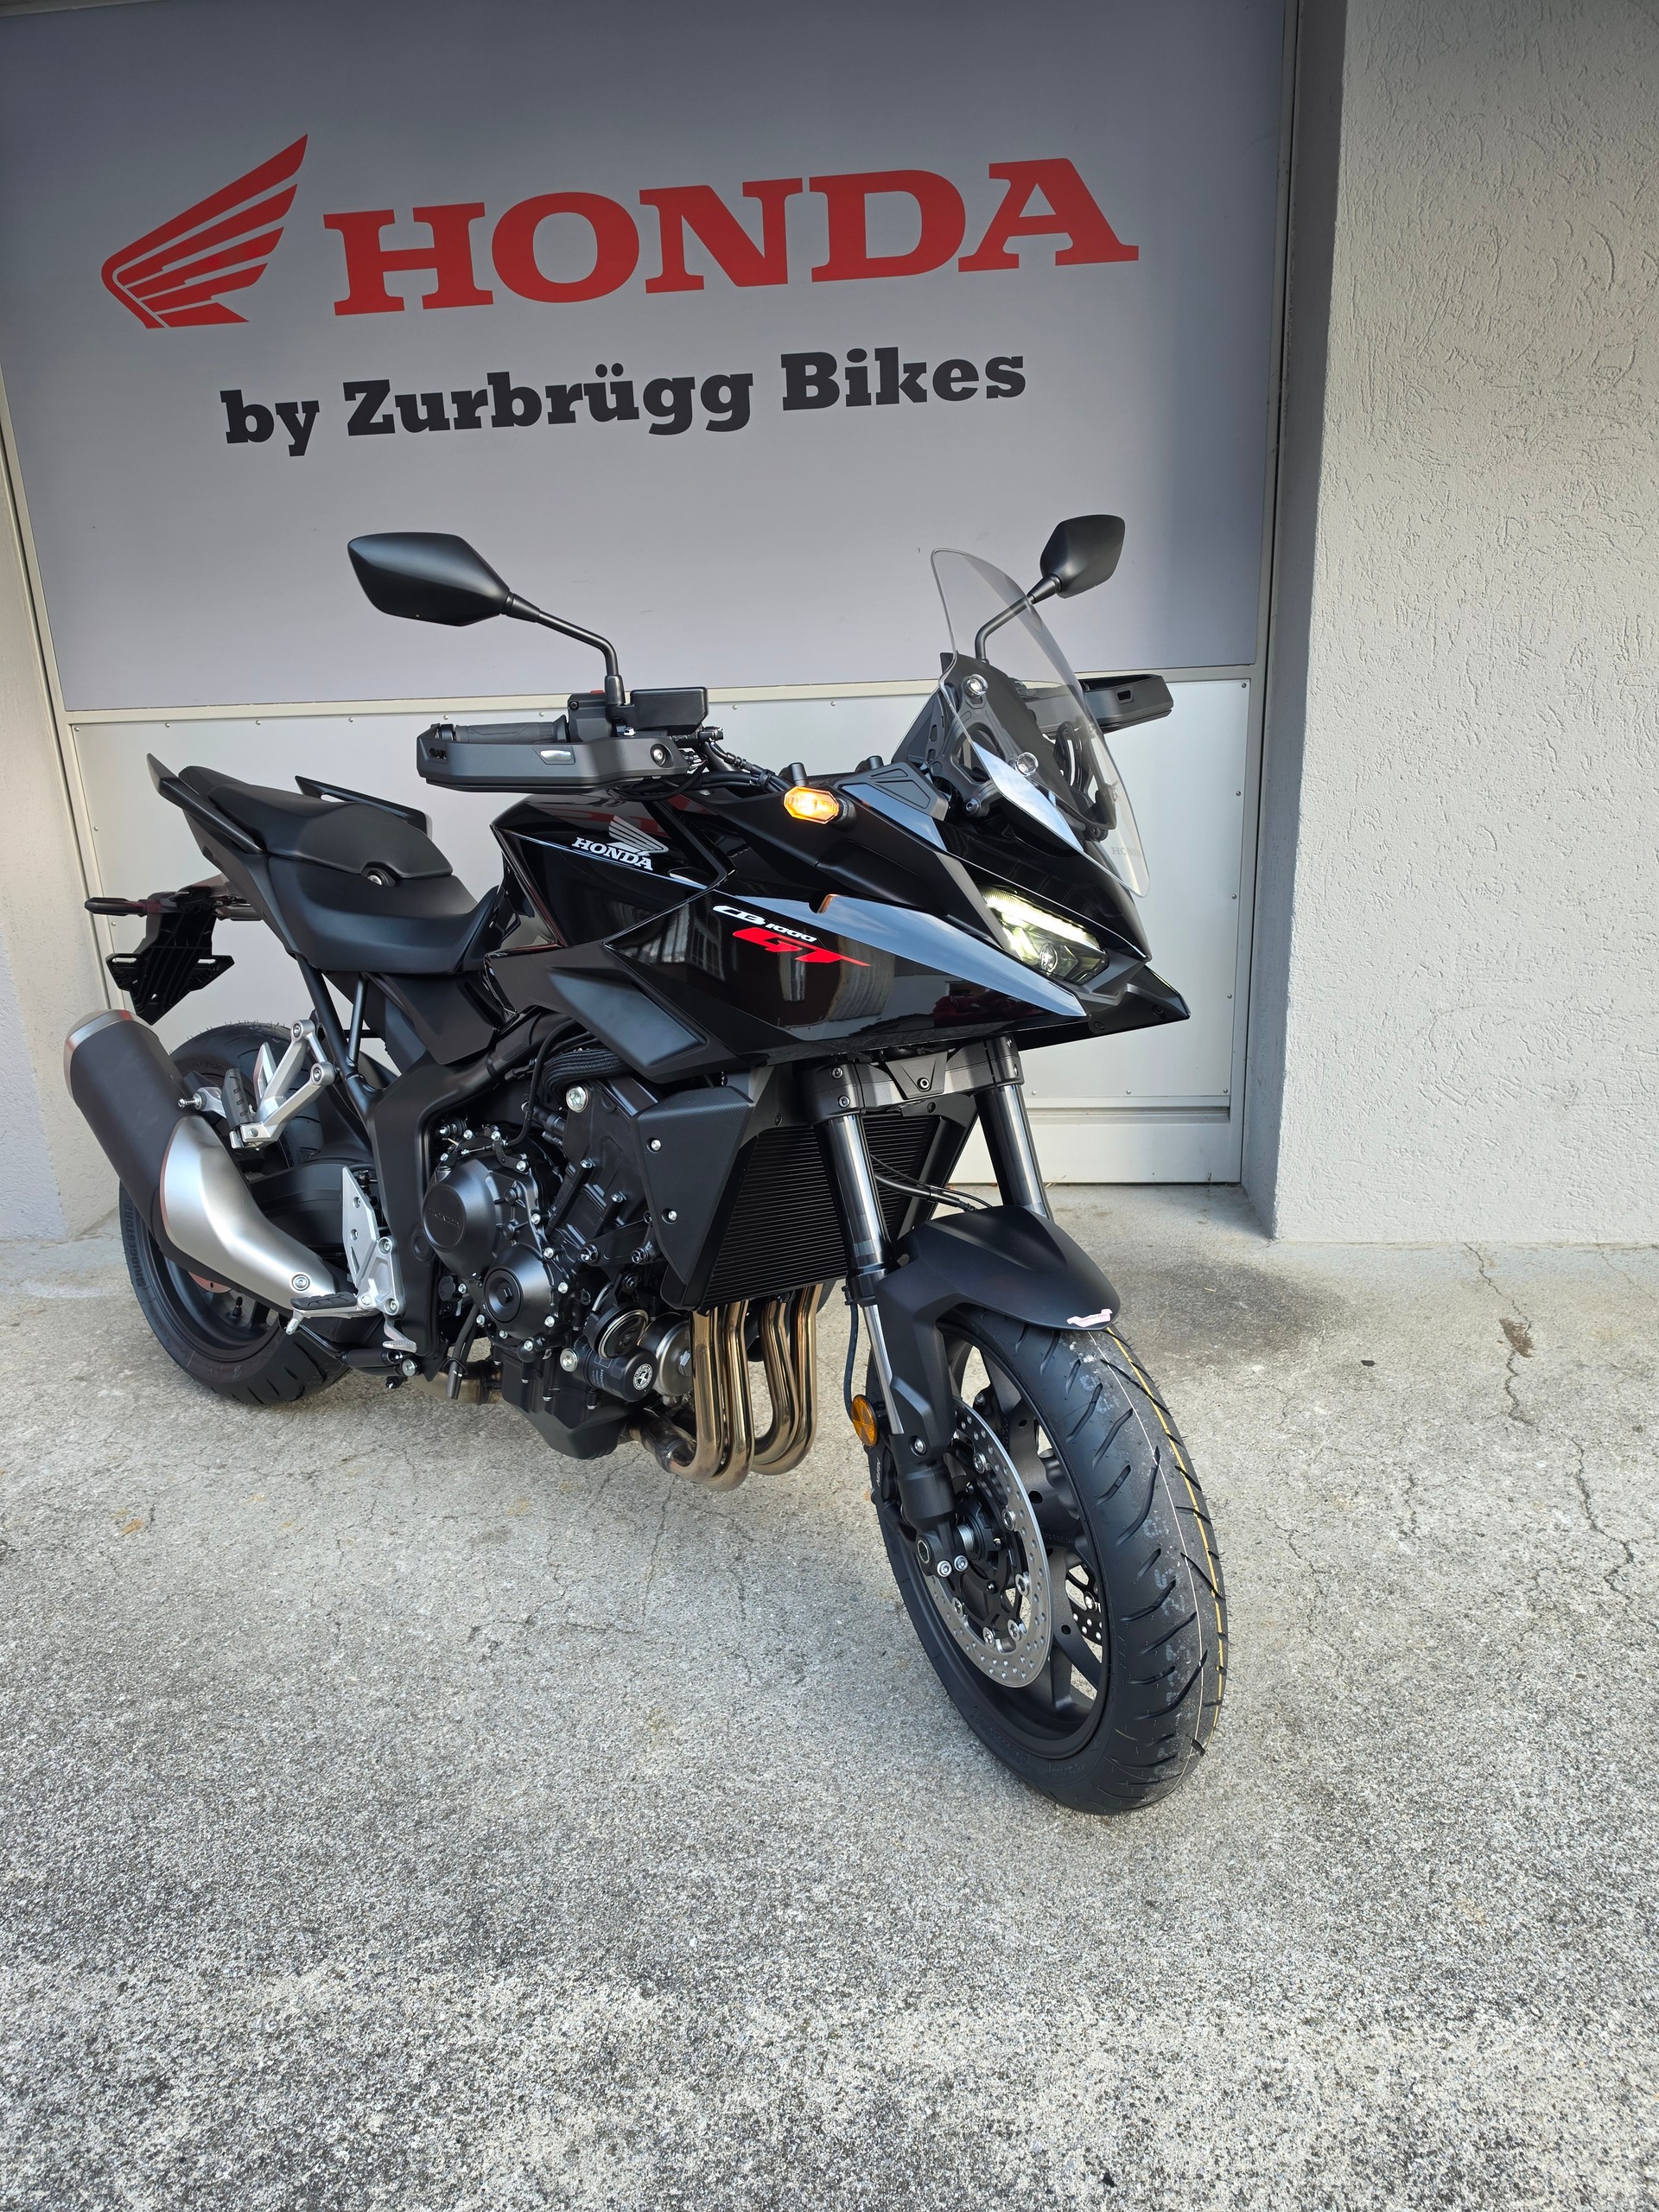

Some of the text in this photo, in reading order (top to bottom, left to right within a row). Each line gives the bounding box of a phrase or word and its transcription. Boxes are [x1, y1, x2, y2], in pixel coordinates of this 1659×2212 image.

[323, 158, 1139, 315] HONDA
[219, 346, 1026, 457] by Zurbrügg Bikes
[571, 836, 653, 871] HONDA
[732, 926, 872, 967] GT
[124, 1201, 147, 1287] BRIDGESTONE
